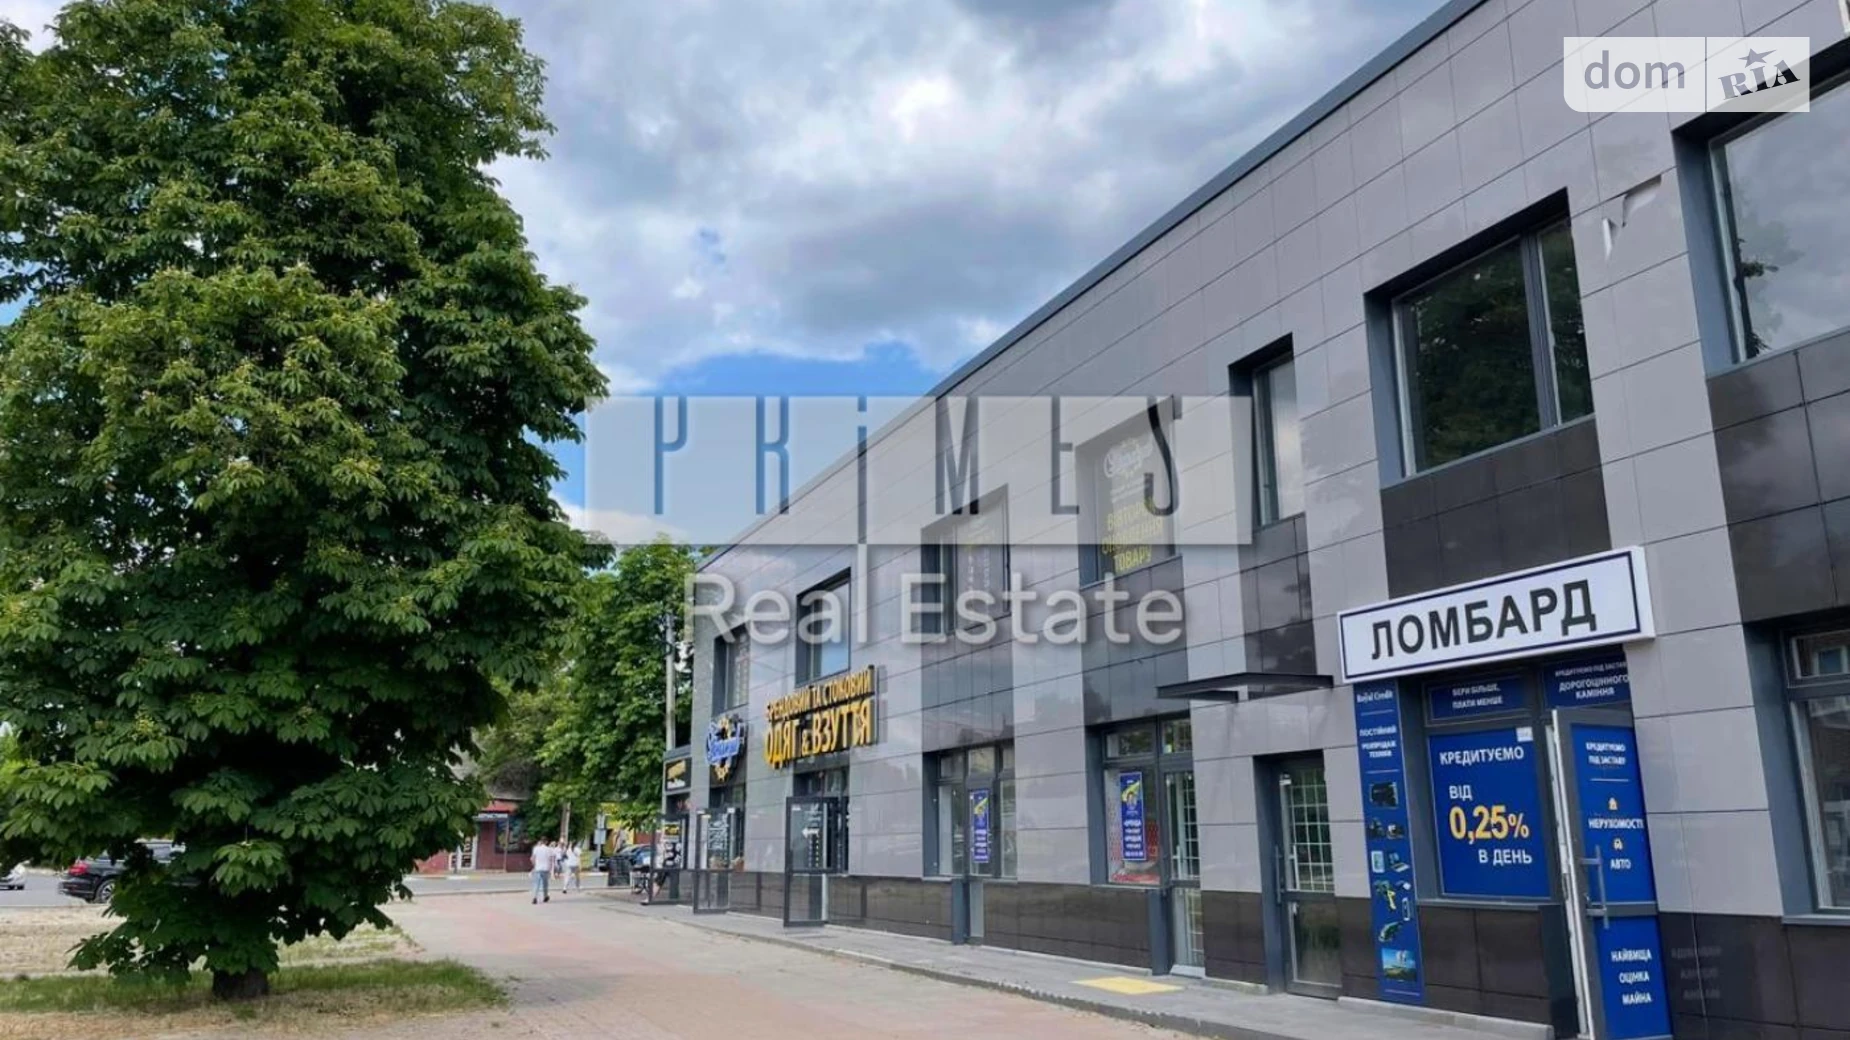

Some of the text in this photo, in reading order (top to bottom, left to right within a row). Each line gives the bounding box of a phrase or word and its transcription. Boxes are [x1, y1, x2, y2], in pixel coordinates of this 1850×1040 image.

[1372, 580, 1597, 660] ЛОМБАРД
[766, 667, 872, 720] БРЕНДОВИЙ ТА СТОКОВИЙ
[1356, 689, 1393, 705] Royal Credit
[1452, 687, 1470, 696] БЕРИ
[1576, 687, 1615, 699] КАМІННЯ
[1452, 696, 1503, 709] ПЛАТИ МЕНШЕ
[764, 718, 800, 768] ОДЯГ
[801, 729, 812, 757] &
[812, 698, 872, 753] ВЗУТТЯ
[1359, 725, 1397, 737] ПОСТІЙНИЙ
[1439, 746, 1525, 767] КРЕДИТУЄМО
[1448, 784, 1473, 802] ВІД
[1449, 805, 1530, 845] 0,25%
[1478, 848, 1533, 866] В ДЕНЬ
[1610, 858, 1632, 870] АВТО
[1611, 948, 1652, 963] НАЙВИЩА
[1619, 971, 1650, 985] ОЦІНКА
[1622, 991, 1652, 1006] МАЙНА
